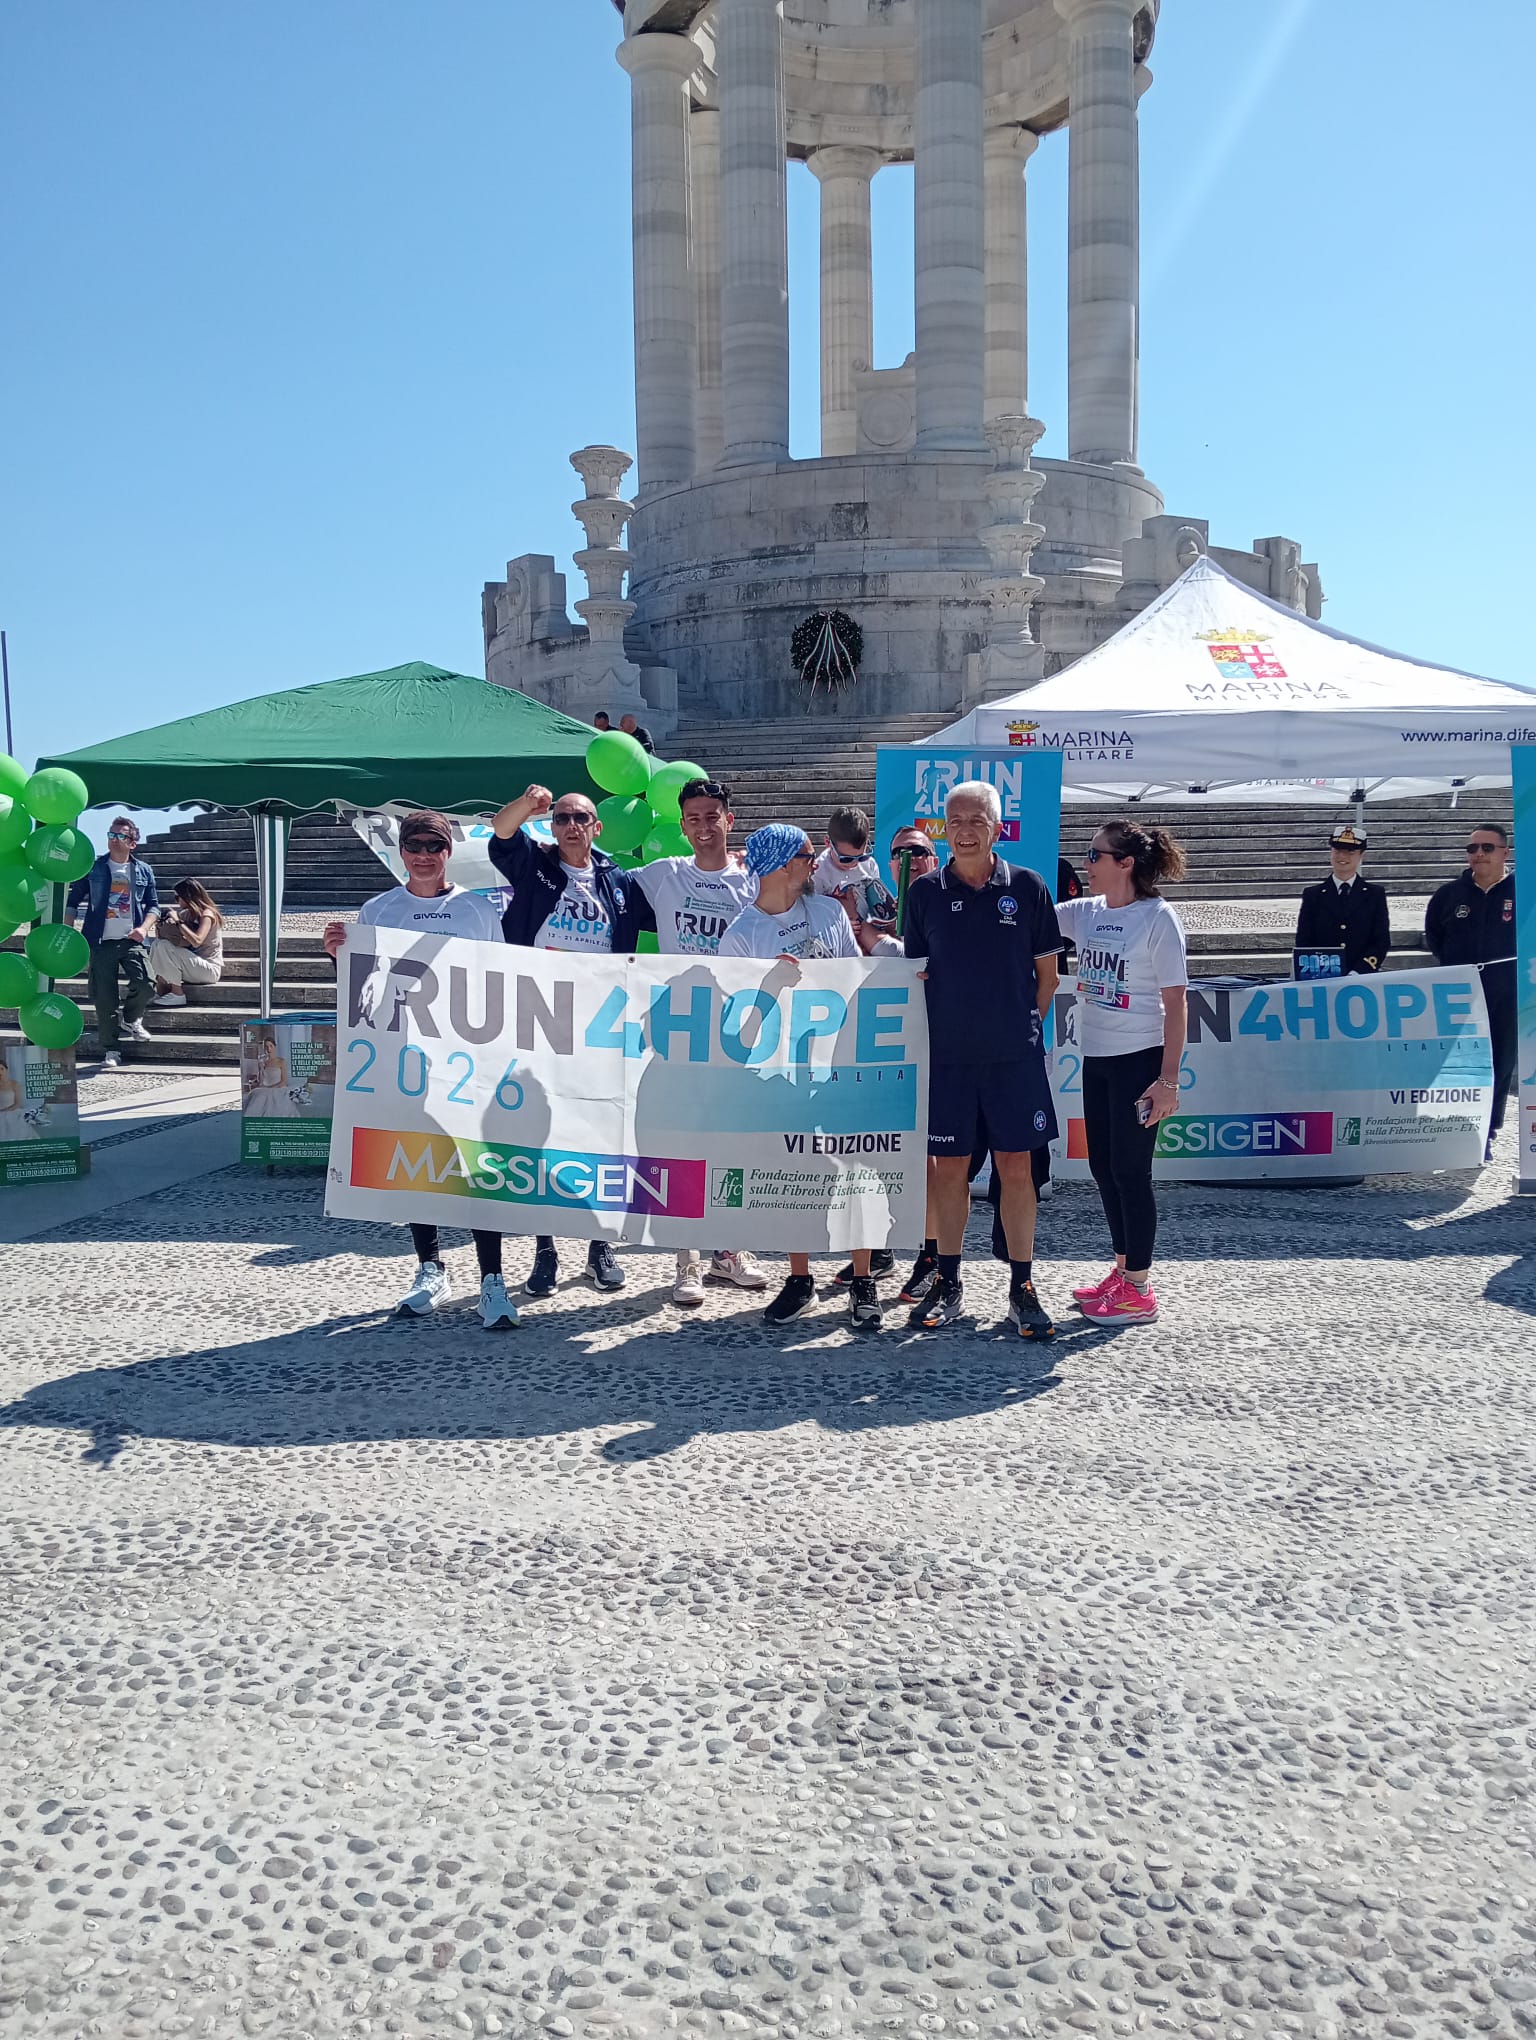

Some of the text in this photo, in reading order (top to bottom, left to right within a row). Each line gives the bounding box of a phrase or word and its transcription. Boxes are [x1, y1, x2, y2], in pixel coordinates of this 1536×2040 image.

[1185, 682, 1343, 693] MARINA
[1193, 693, 1352, 701] MILITARE
[1042, 730, 1134, 747] MARINA
[1067, 749, 1134, 761] LITARE
[413, 912, 452, 920] GIVOVA
[1095, 924, 1124, 933] GIVOVA
[1387, 1041, 1480, 1052] ITALIA
[346, 1039, 524, 1110] 2026
[787, 1070, 904, 1082] ITALIA
[1389, 1089, 1481, 1104] VI EDIZIONE
[1365, 1116, 1415, 1126] Fondazione
[1418, 1116, 1434, 1125] per
[1446, 1114, 1482, 1122] Ricerca
[1365, 1127, 1386, 1135] sulla
[1388, 1126, 1421, 1135] Fibrosi
[1423, 1125, 1452, 1134] Cistica
[1460, 1123, 1481, 1132] ETS
[1155, 1120, 1305, 1152] SSIGEN
[784, 1133, 902, 1155] VI EDIZIONE
[749, 1168, 904, 1185] Fondazione per la Ricerca
[713, 1171, 742, 1200] ffc
[749, 1183, 779, 1195] sulla
[781, 1184, 825, 1197] Fibrosi
[827, 1183, 866, 1196] Cistica
[876, 1183, 904, 1195] ETS
[747, 1199, 846, 1210] fibrosicisticaricerca.it
